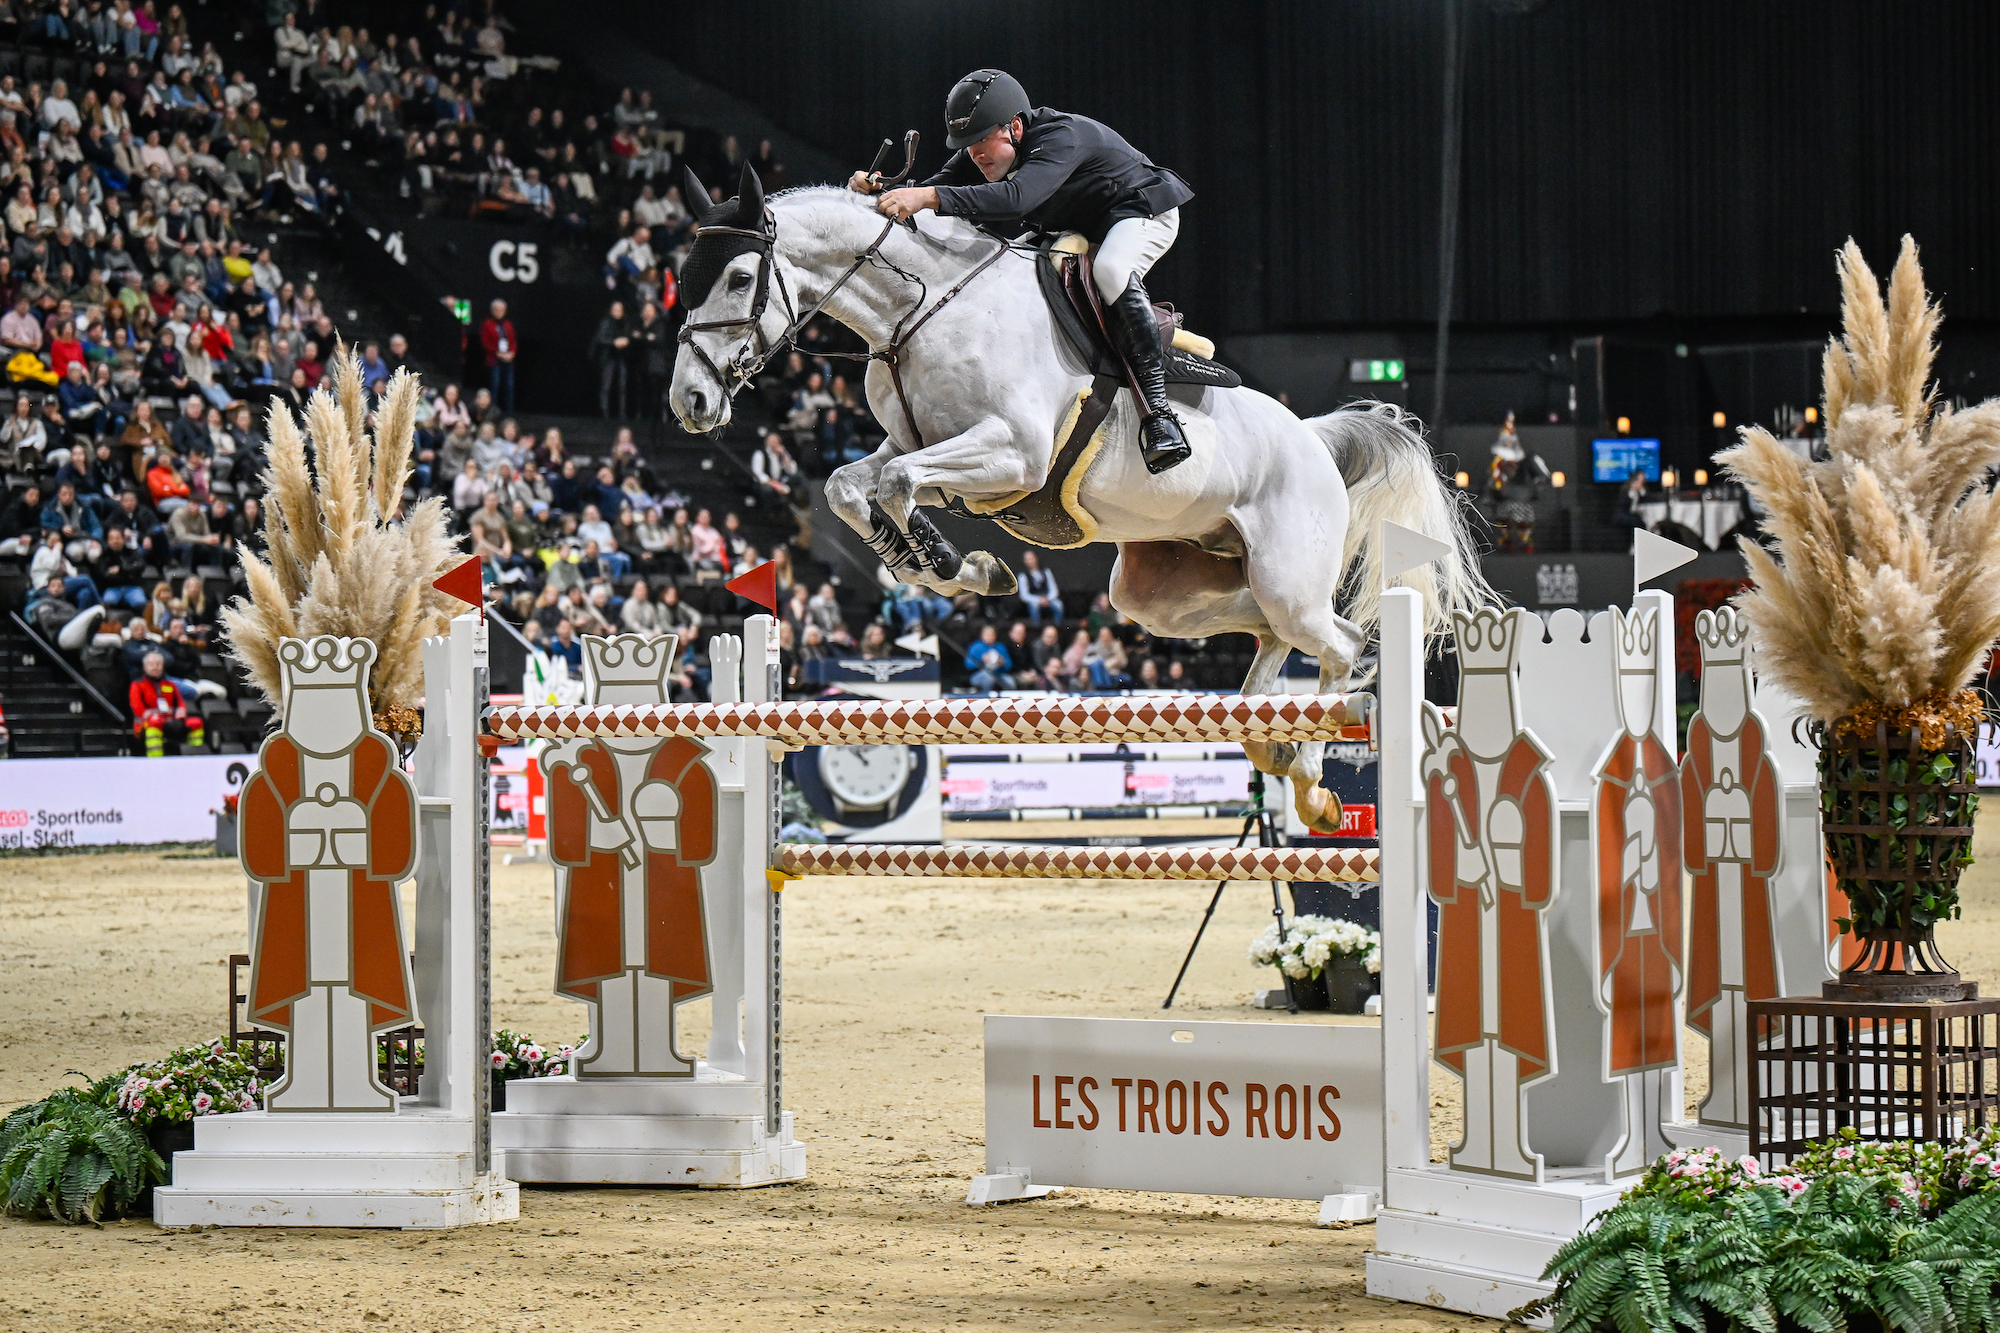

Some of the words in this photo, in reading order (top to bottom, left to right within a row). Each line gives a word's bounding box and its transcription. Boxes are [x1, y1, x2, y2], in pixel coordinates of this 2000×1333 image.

[489, 239, 540, 284] C5
[1033, 1074, 1099, 1131] LES
[1111, 1077, 1230, 1137] TROIS
[1245, 1083, 1341, 1142] ROIS
